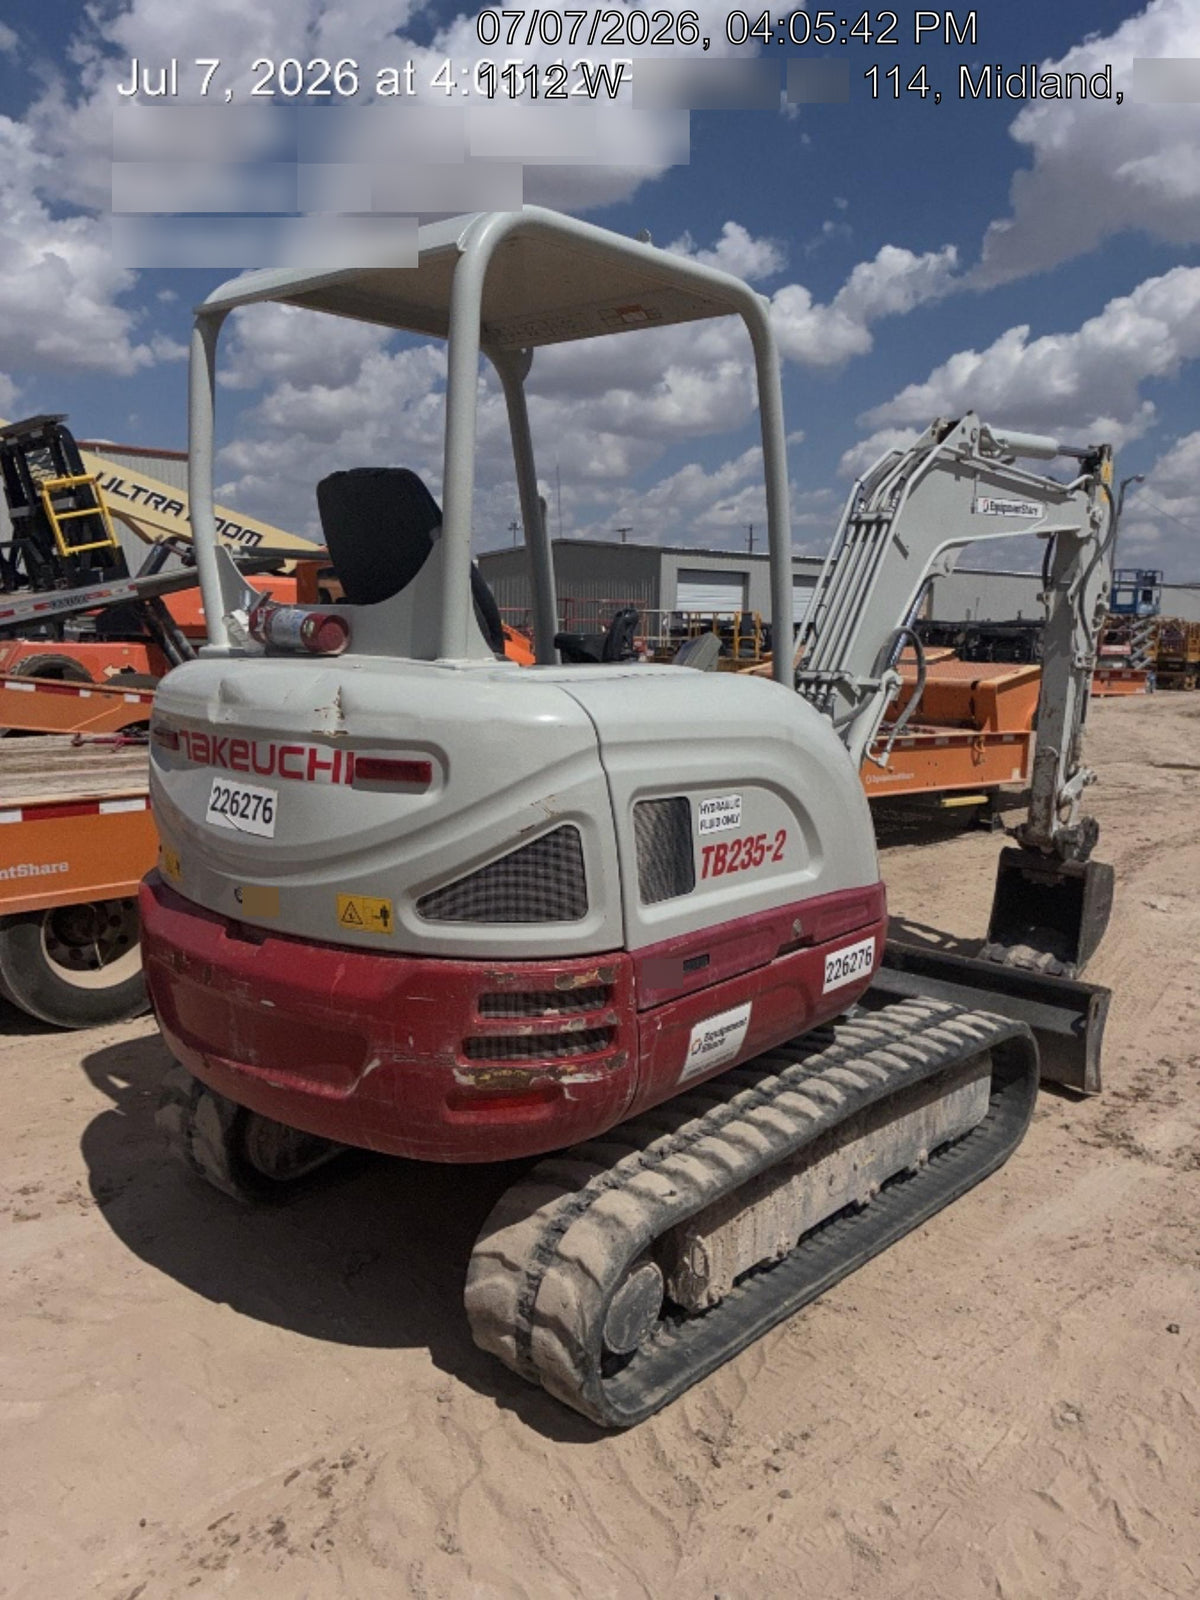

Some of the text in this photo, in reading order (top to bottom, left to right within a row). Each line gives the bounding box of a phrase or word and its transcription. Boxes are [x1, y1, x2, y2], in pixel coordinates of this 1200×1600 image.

[96, 471, 185, 517] ULTRA
[210, 785, 274, 824] 226276
[702, 829, 787, 880] TB235-2
[826, 945, 872, 983] 226276
